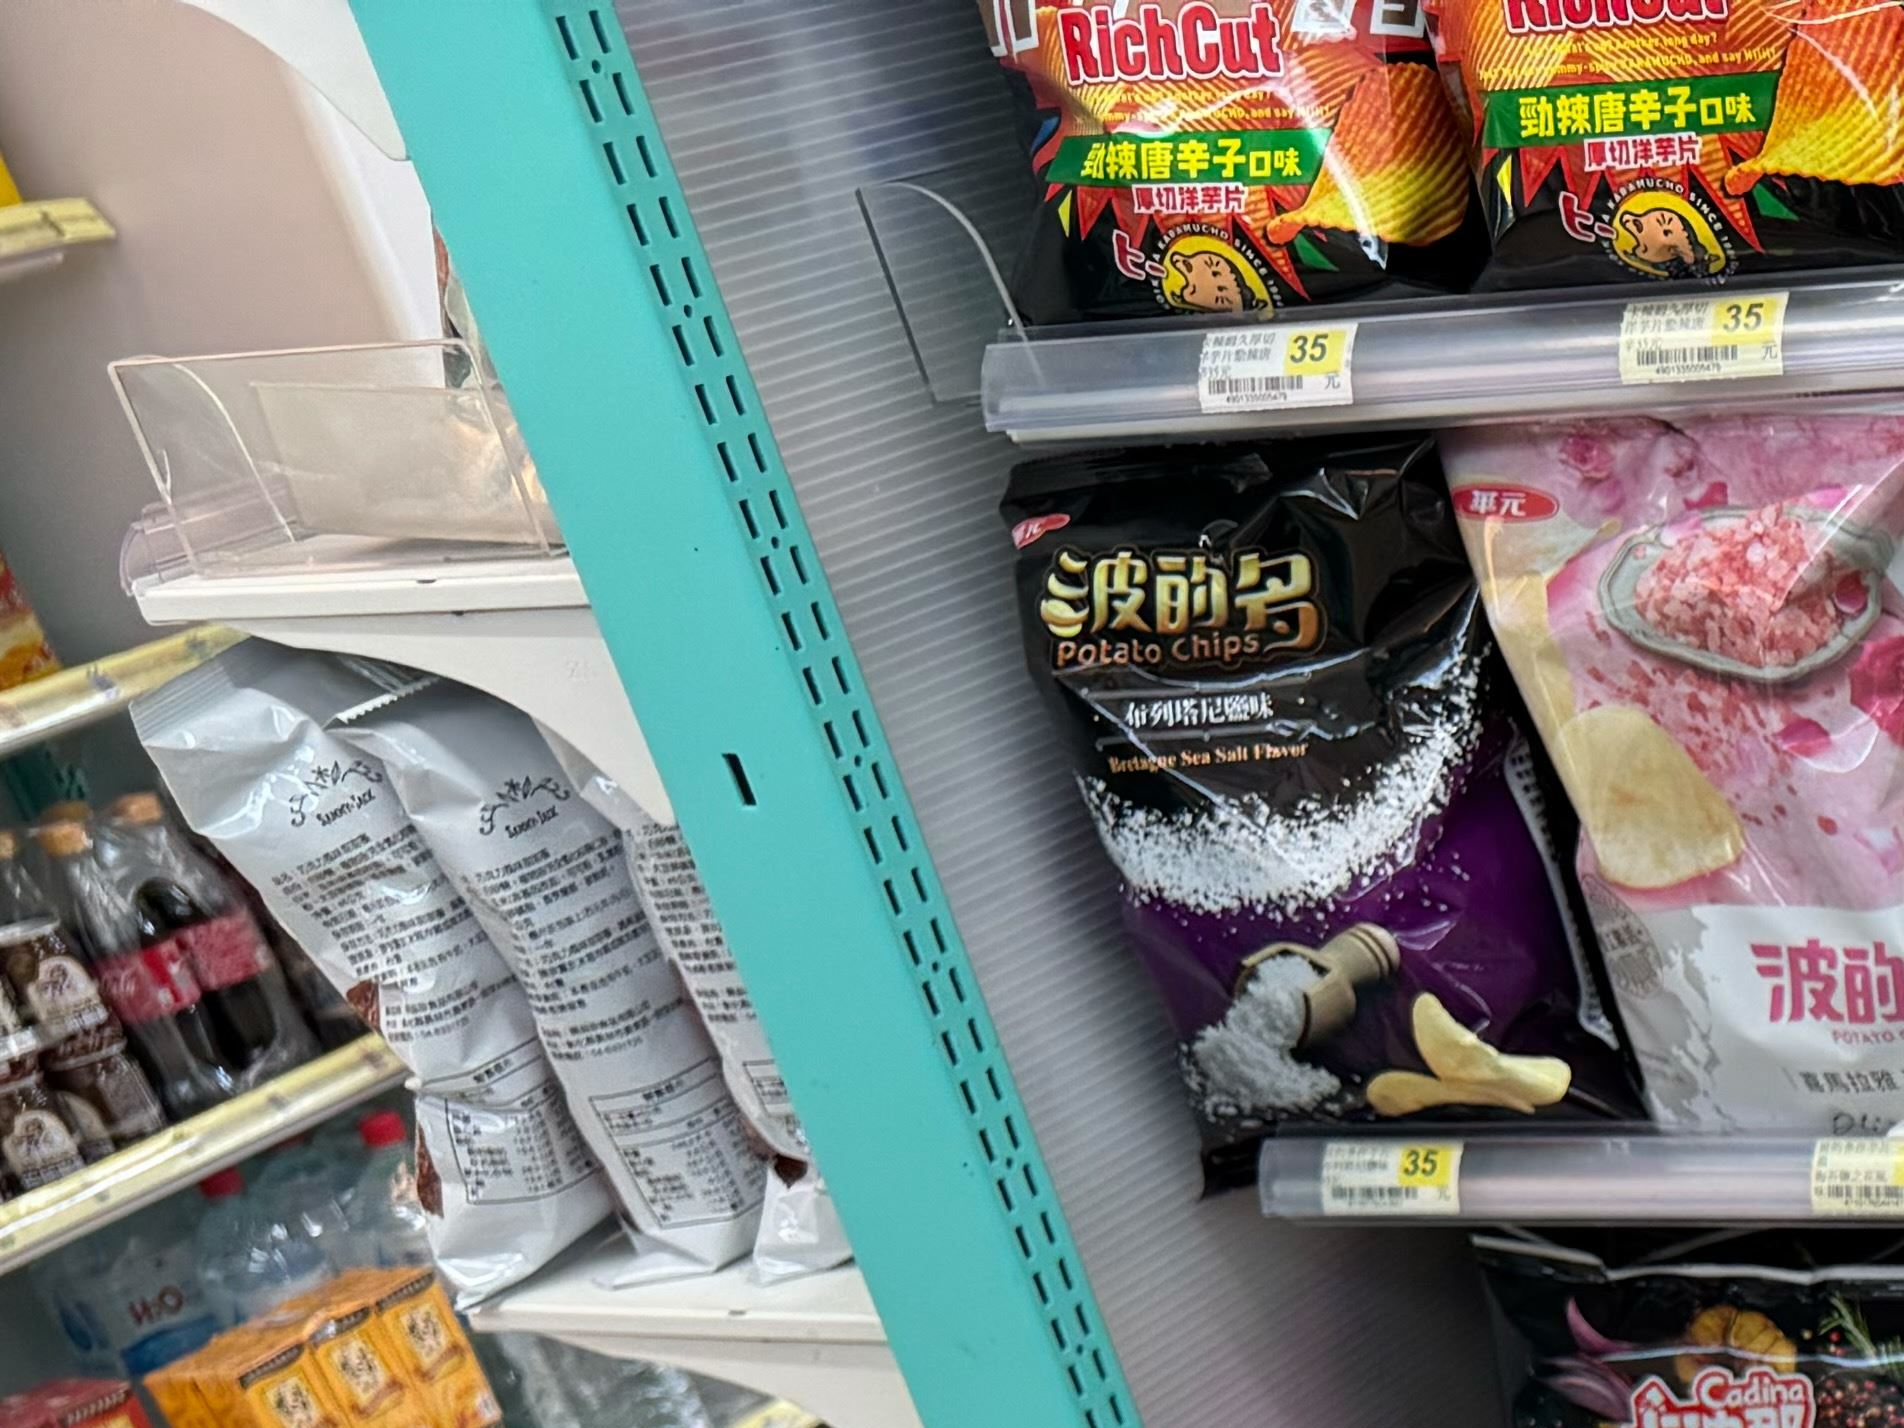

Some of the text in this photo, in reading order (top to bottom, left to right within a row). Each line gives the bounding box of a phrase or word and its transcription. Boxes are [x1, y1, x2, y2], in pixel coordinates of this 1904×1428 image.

[1058, 2, 1285, 86] RichCut
[1519, 86, 1755, 137] 勁辣唐辛子口味
[1080, 137, 1302, 180] 勁辣唐辛子口味
[1584, 133, 1701, 172] 厚切洋芋片
[1133, 184, 1248, 215] 厚切洋芋片
[1723, 303, 1765, 335] 35
[1289, 333, 1329, 364] 35
[1762, 344, 1780, 362] 元
[1322, 372, 1342, 390] 元
[1472, 491, 1528, 518] 華元
[1041, 550, 1320, 650] 波的多
[1057, 632, 1262, 669] Potato Chips
[1125, 692, 1275, 728] 布列塔尼鹽味
[1180, 748, 1211, 767] Sea
[1213, 745, 1249, 765] Salt
[1253, 741, 1309, 762] Flavor
[1831, 1029, 1895, 1046] POTATO
[1402, 1149, 1439, 1177] 35
[1699, 1372, 1804, 1408] Cadina
